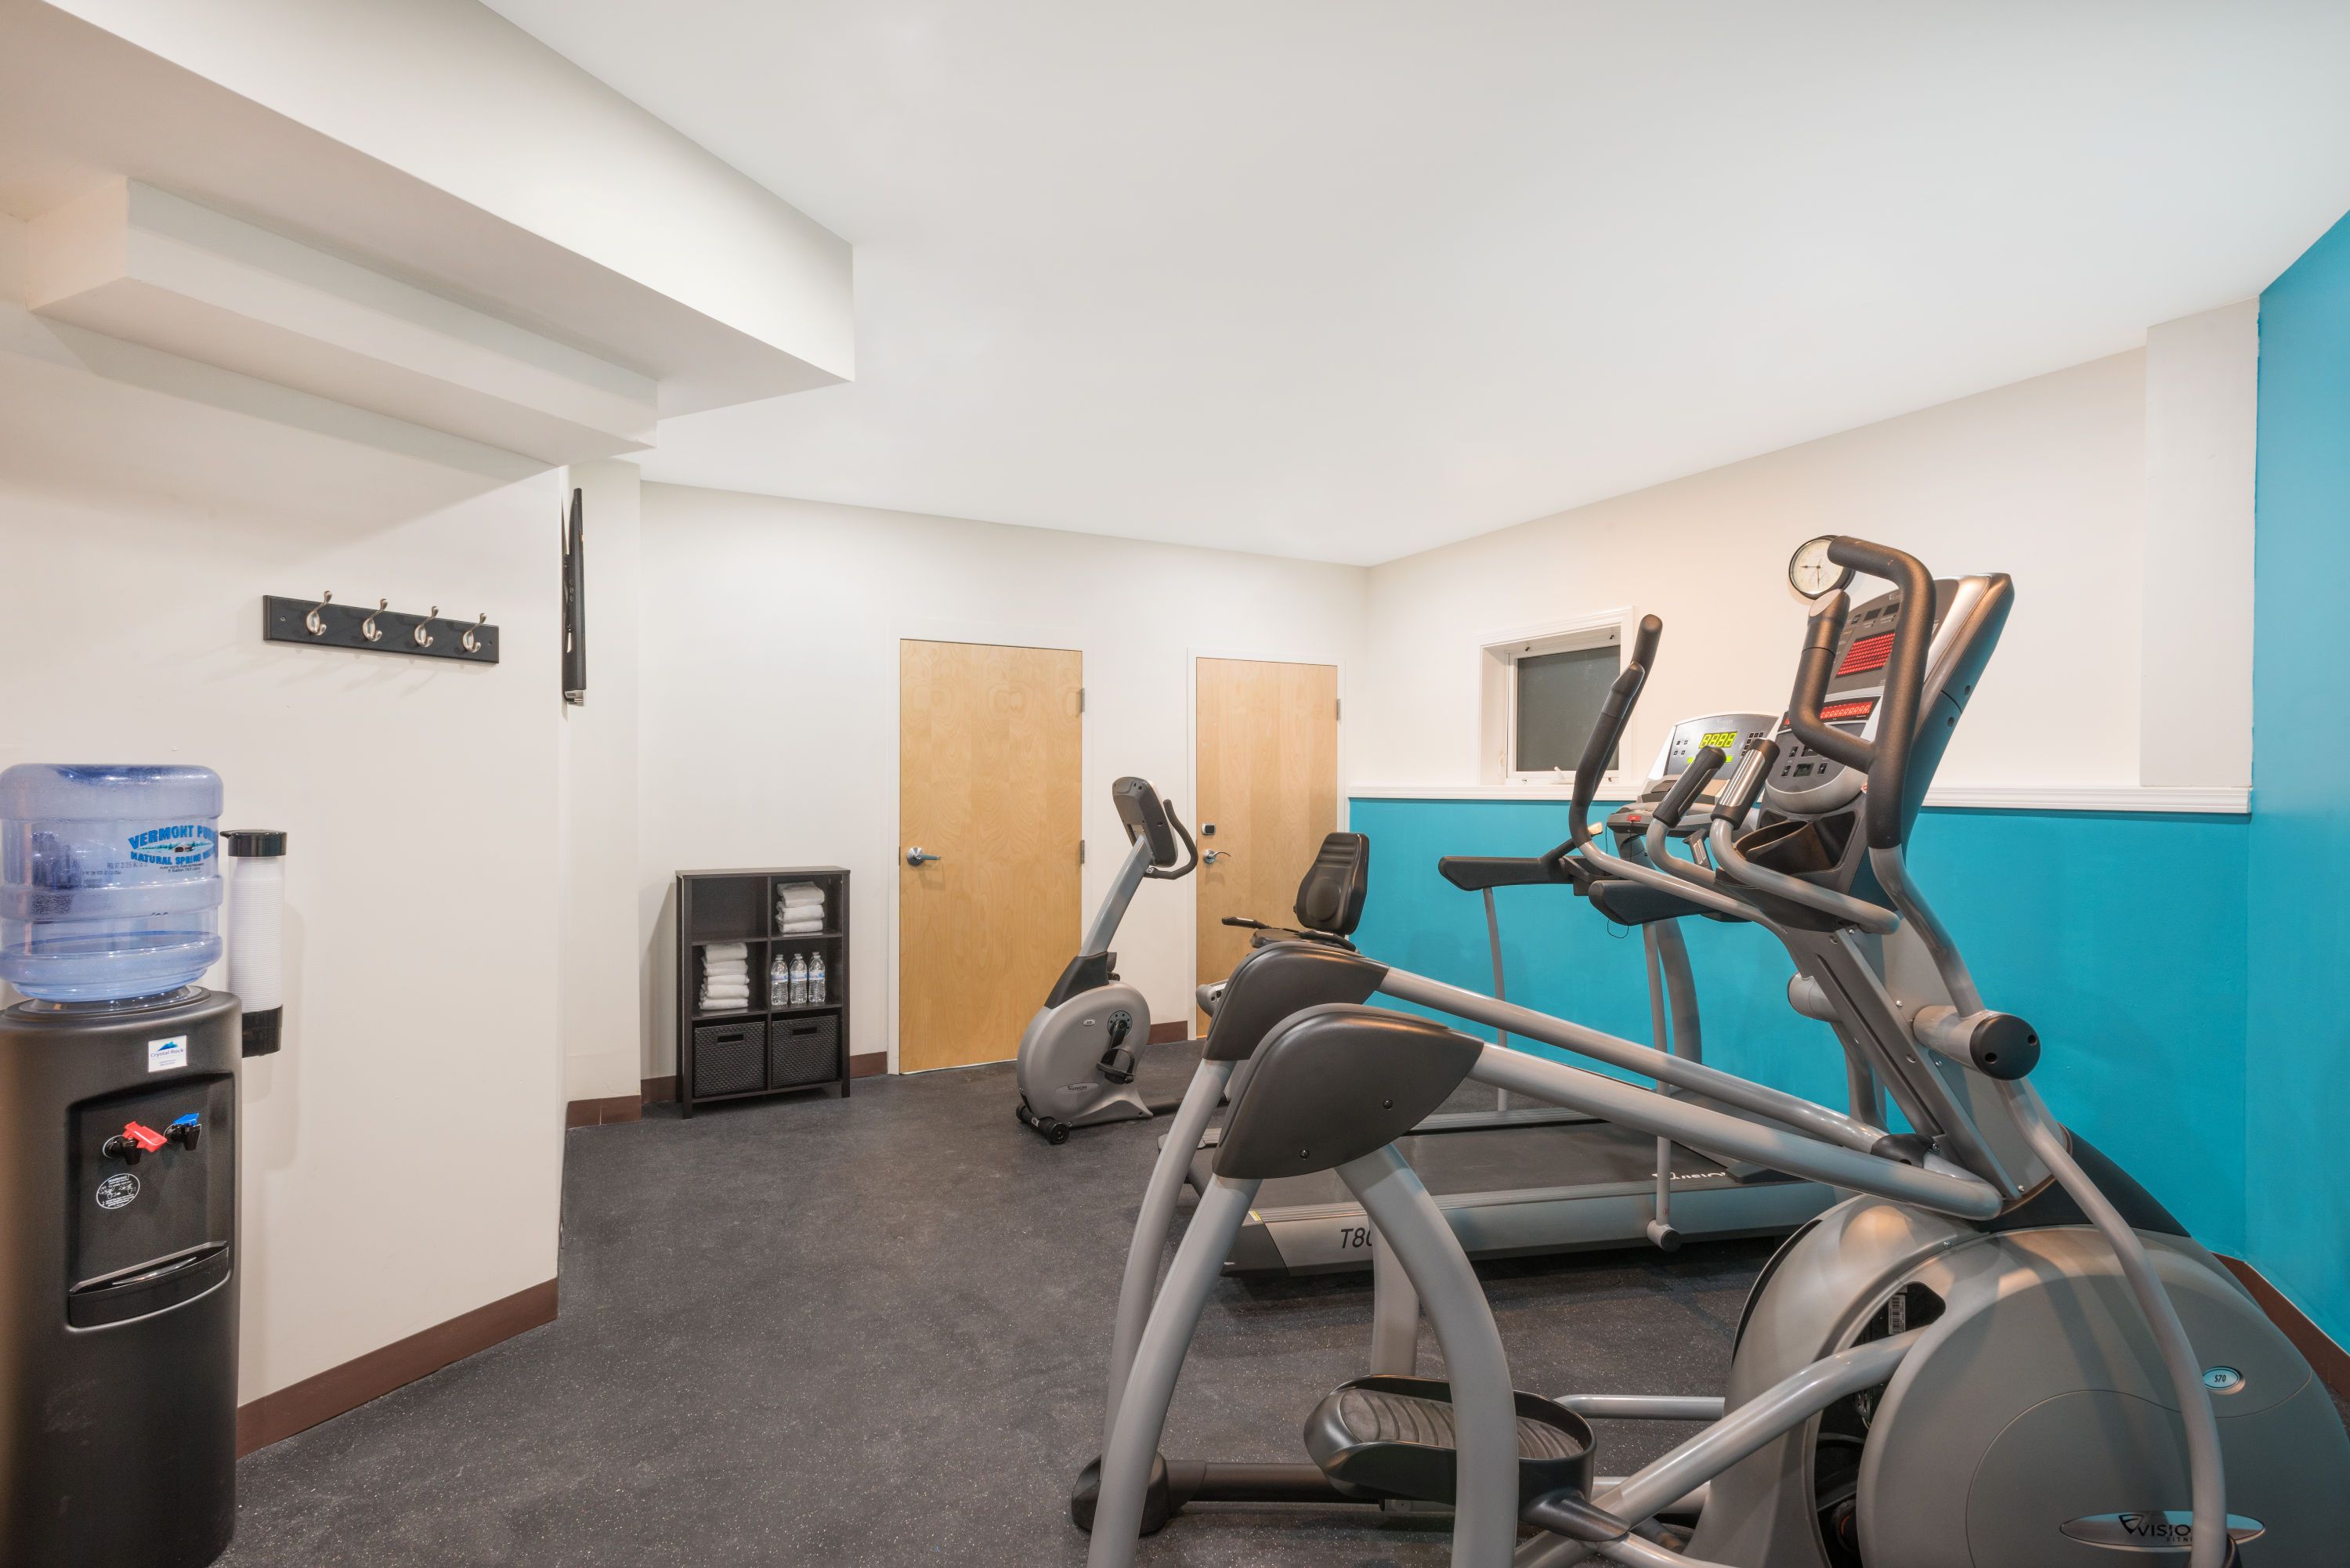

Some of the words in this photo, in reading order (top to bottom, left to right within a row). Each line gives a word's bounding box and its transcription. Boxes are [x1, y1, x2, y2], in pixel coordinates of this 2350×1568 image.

[128, 825, 193, 850] VERMONT
[131, 851, 172, 865] NATURAL
[2137, 1524, 2191, 1537] VISIO
